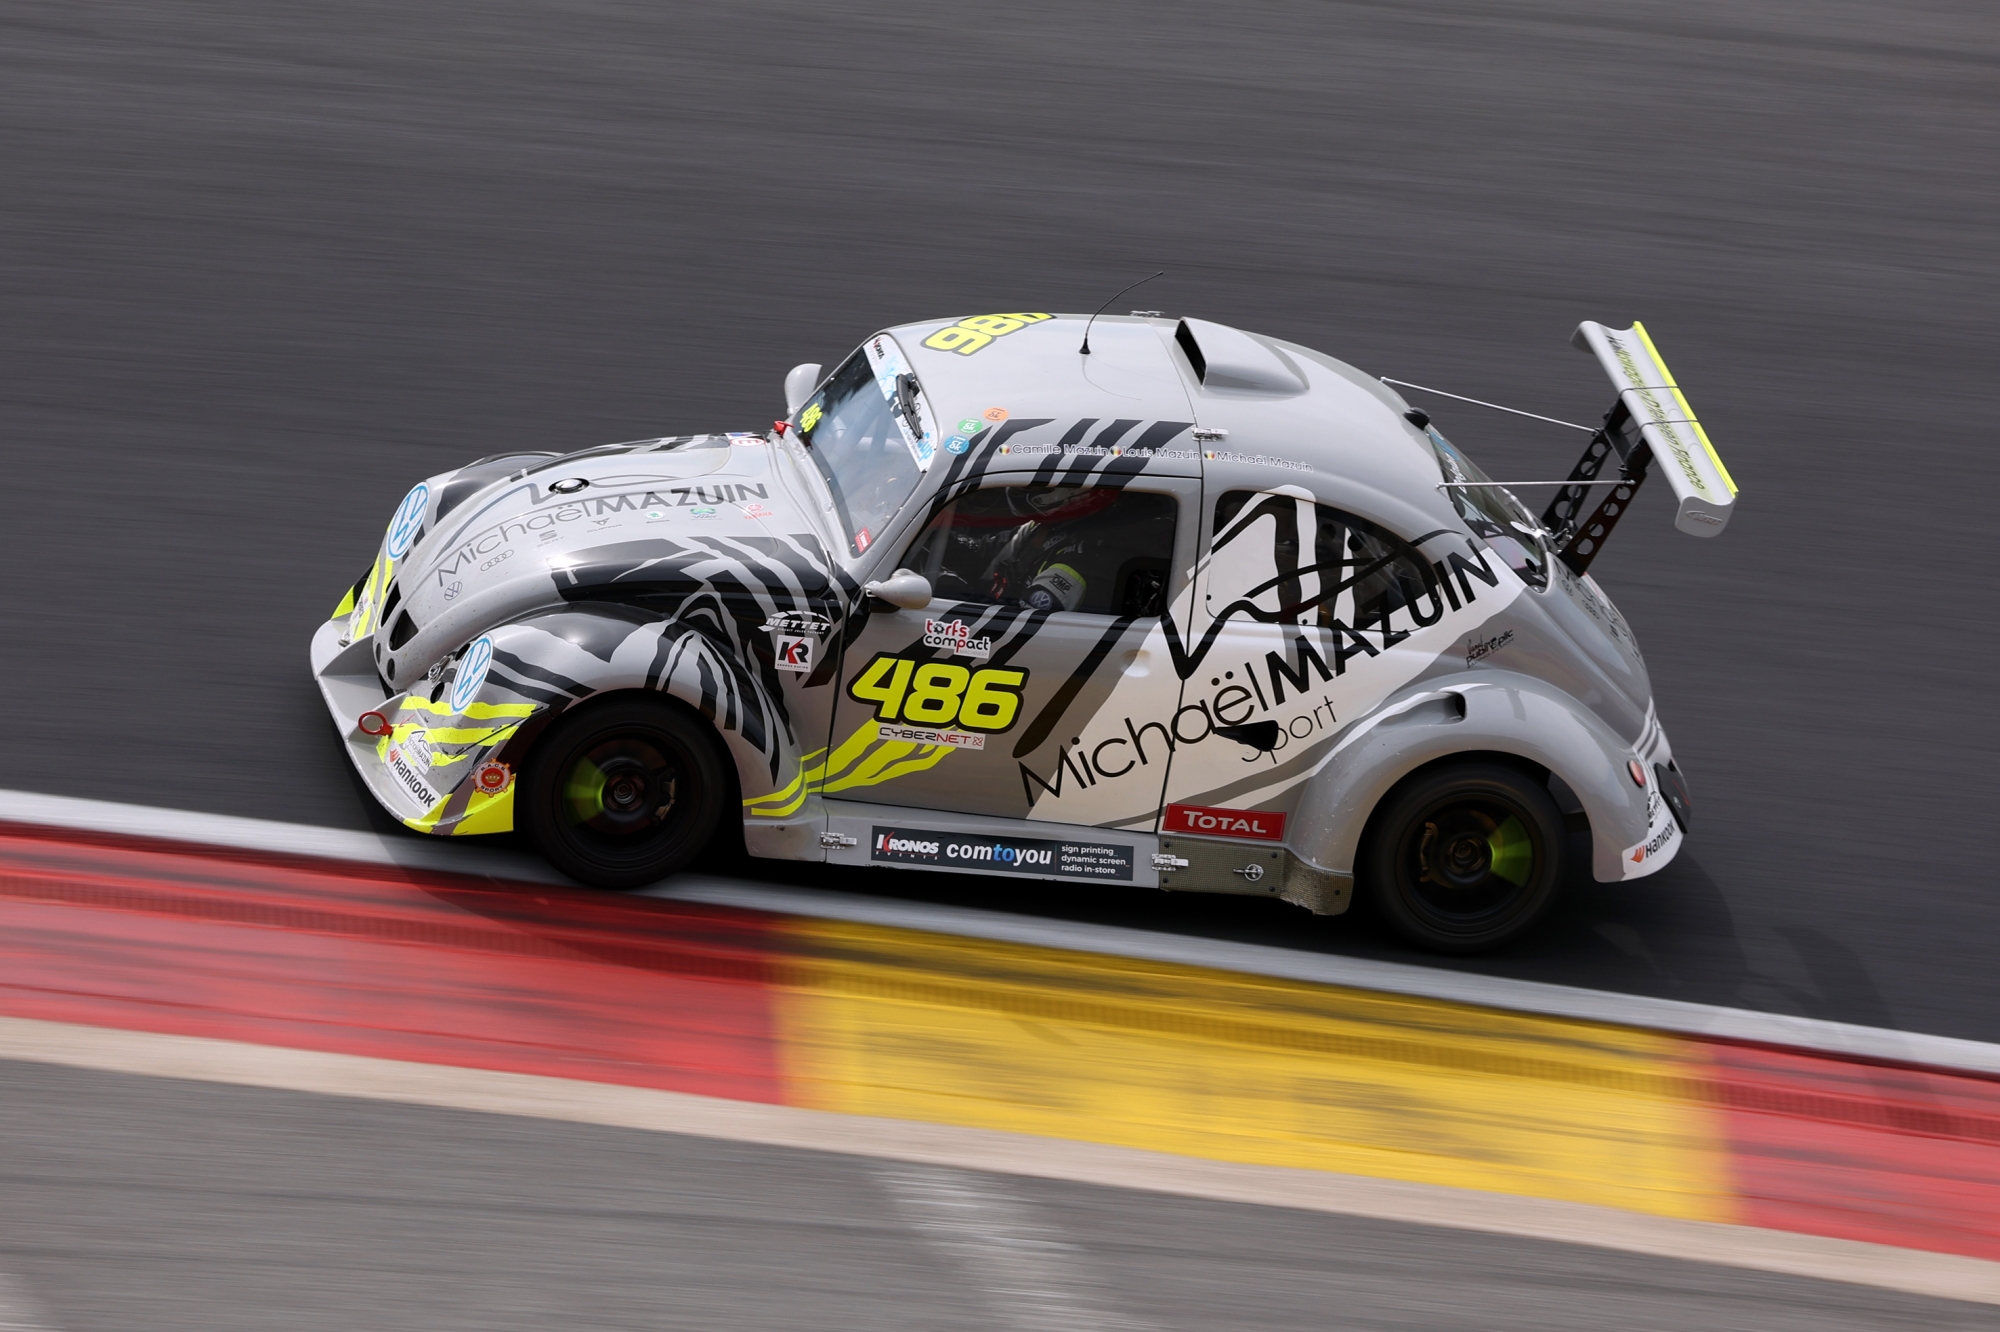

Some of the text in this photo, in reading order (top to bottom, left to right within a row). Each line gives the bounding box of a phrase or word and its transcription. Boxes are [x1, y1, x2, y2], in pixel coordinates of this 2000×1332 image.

[1012, 444, 1110, 456] Camille Mazuin
[1122, 446, 1200, 460] Louis Mazuin
[1217, 451, 1314, 473] Michaël Mazuin
[1051, 575, 1072, 593] OMP
[765, 617, 831, 631] METTET
[925, 635, 989, 653] compact
[848, 653, 1028, 732] 486
[876, 832, 940, 854] KRONOS
[1061, 845, 1079, 854] sign
[946, 843, 1053, 867] comtoyou
[1061, 854, 1097, 864] dynamic
